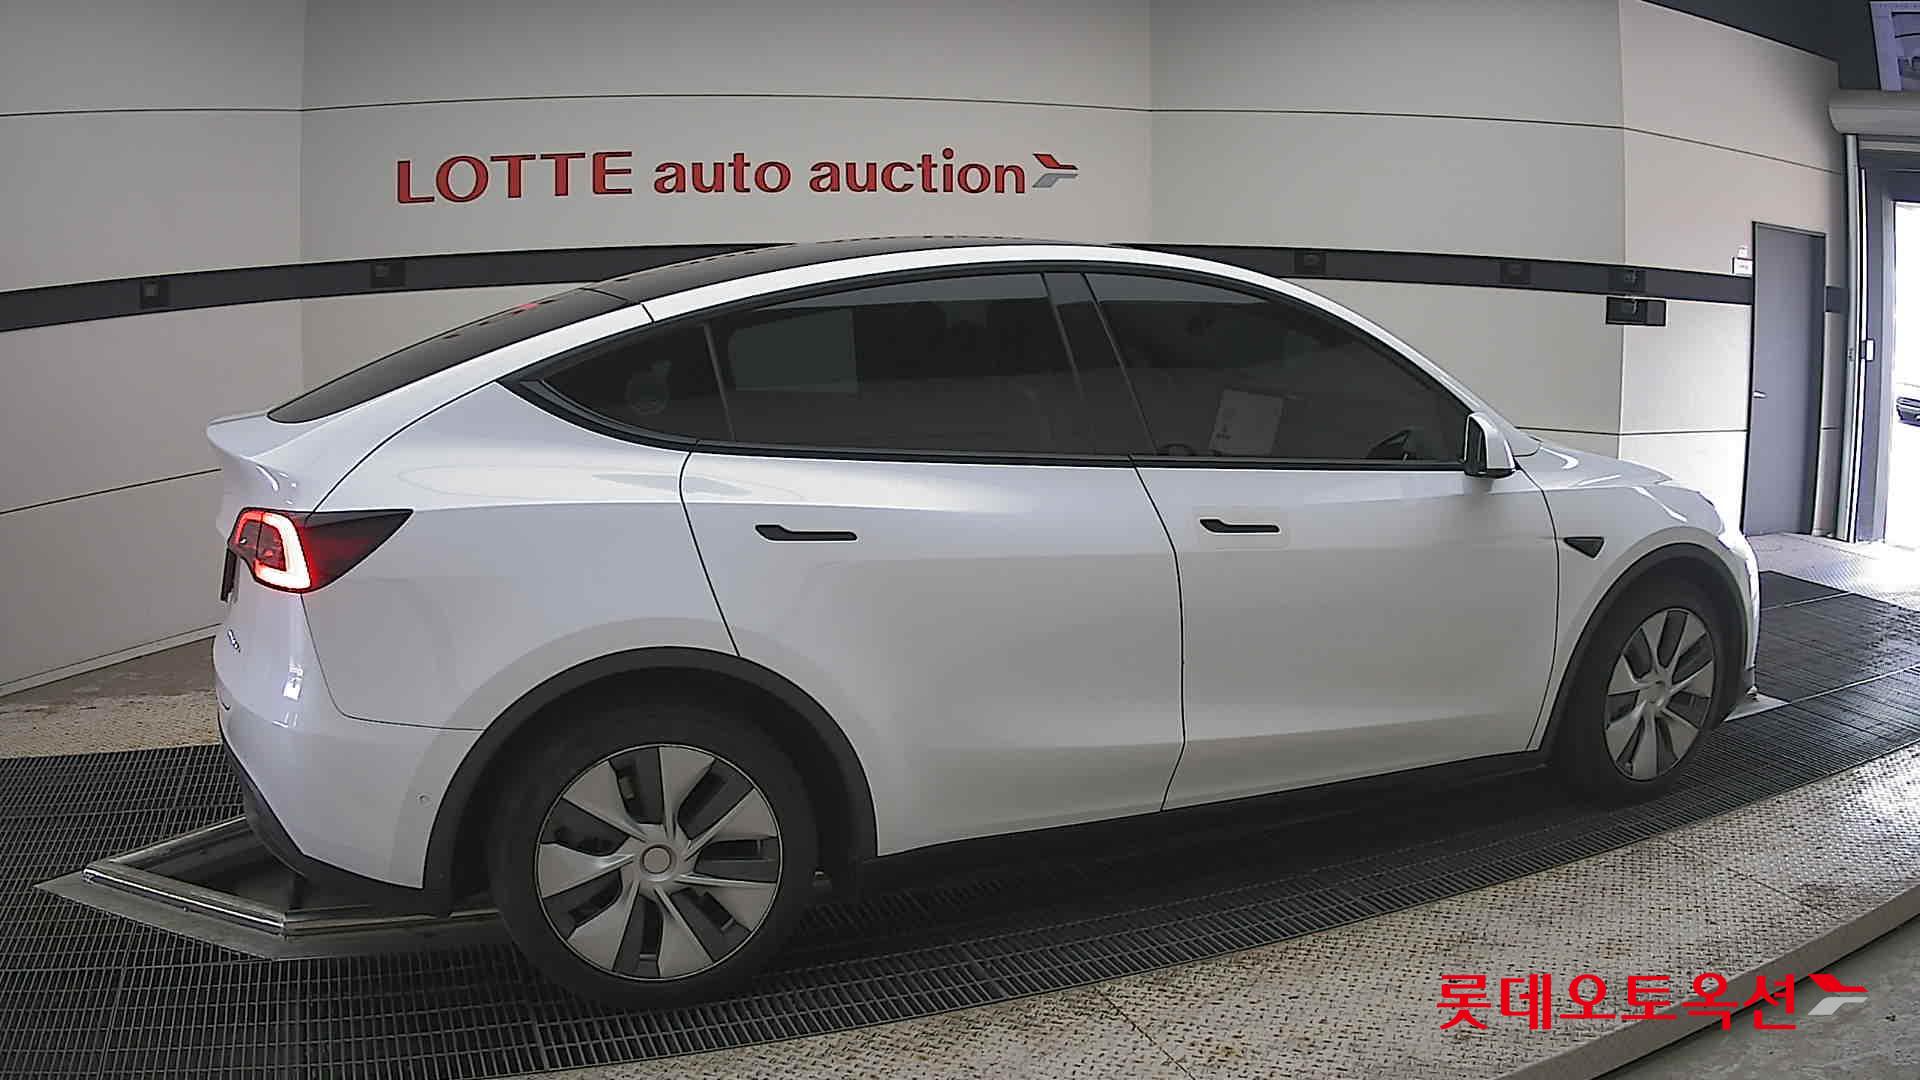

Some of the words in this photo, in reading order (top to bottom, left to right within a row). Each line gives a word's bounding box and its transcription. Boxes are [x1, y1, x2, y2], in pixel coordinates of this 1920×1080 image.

[397, 151, 632, 203] LOTTE
[654, 153, 791, 194] auto
[810, 148, 1025, 194] auction
